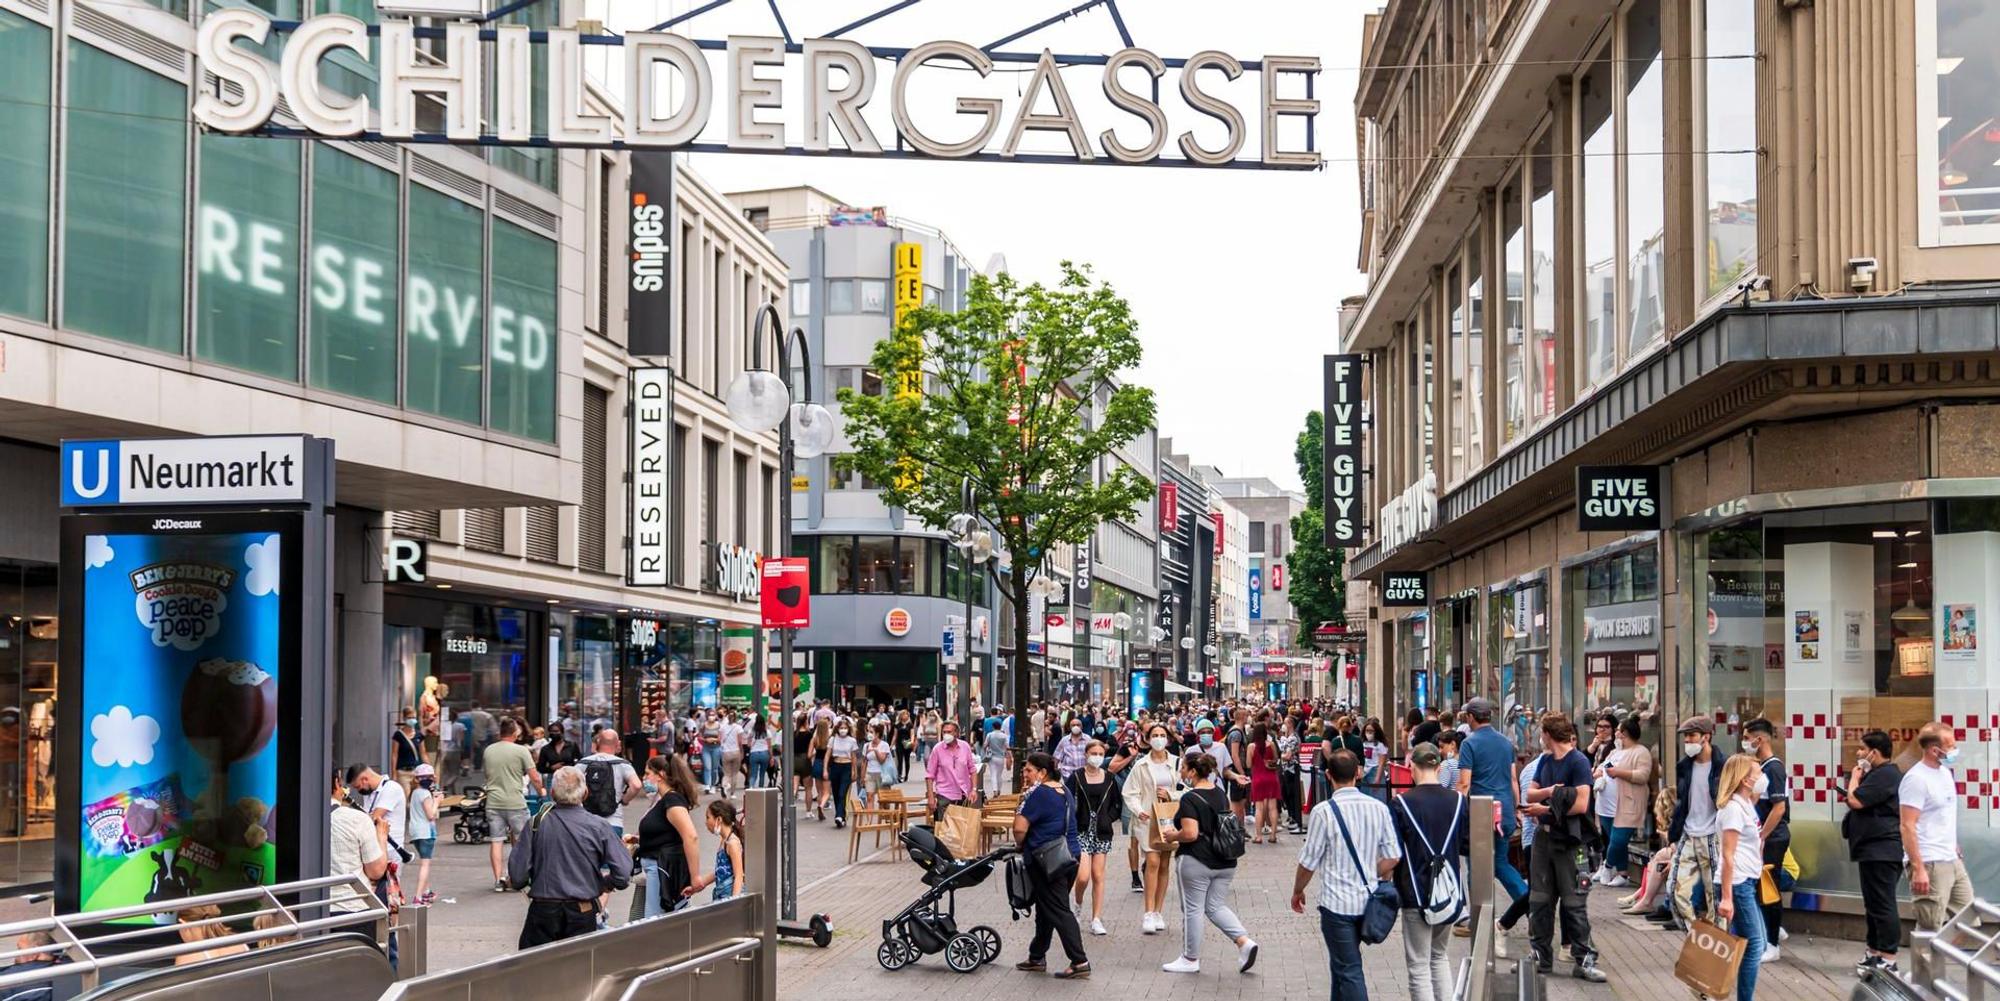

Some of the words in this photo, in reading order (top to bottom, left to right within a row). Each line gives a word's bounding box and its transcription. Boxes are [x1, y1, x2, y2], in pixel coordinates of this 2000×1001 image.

[193, 8, 1322, 170] SCHILDERGASSE
[632, 203, 670, 293] snipes
[200, 205, 548, 371] RESERVED
[1333, 361, 1354, 446] FIVE
[72, 449, 109, 499] U
[130, 450, 294, 489] Neumarkt
[640, 381, 662, 573] RESERVED
[1591, 478, 1648, 497] FIVE
[1333, 455, 1354, 540] GUYS
[1585, 499, 1656, 517] GUYS
[152, 519, 202, 530] JCDecaux
[388, 539, 425, 582] R
[717, 542, 758, 603] snipes
[1386, 589, 1425, 600] GUYS
[1389, 578, 1421, 588] FIVE
[150, 597, 214, 624] peace
[160, 617, 206, 642] pop
[1162, 594, 1172, 637] ZARA
[446, 638, 488, 654] RESERVED
